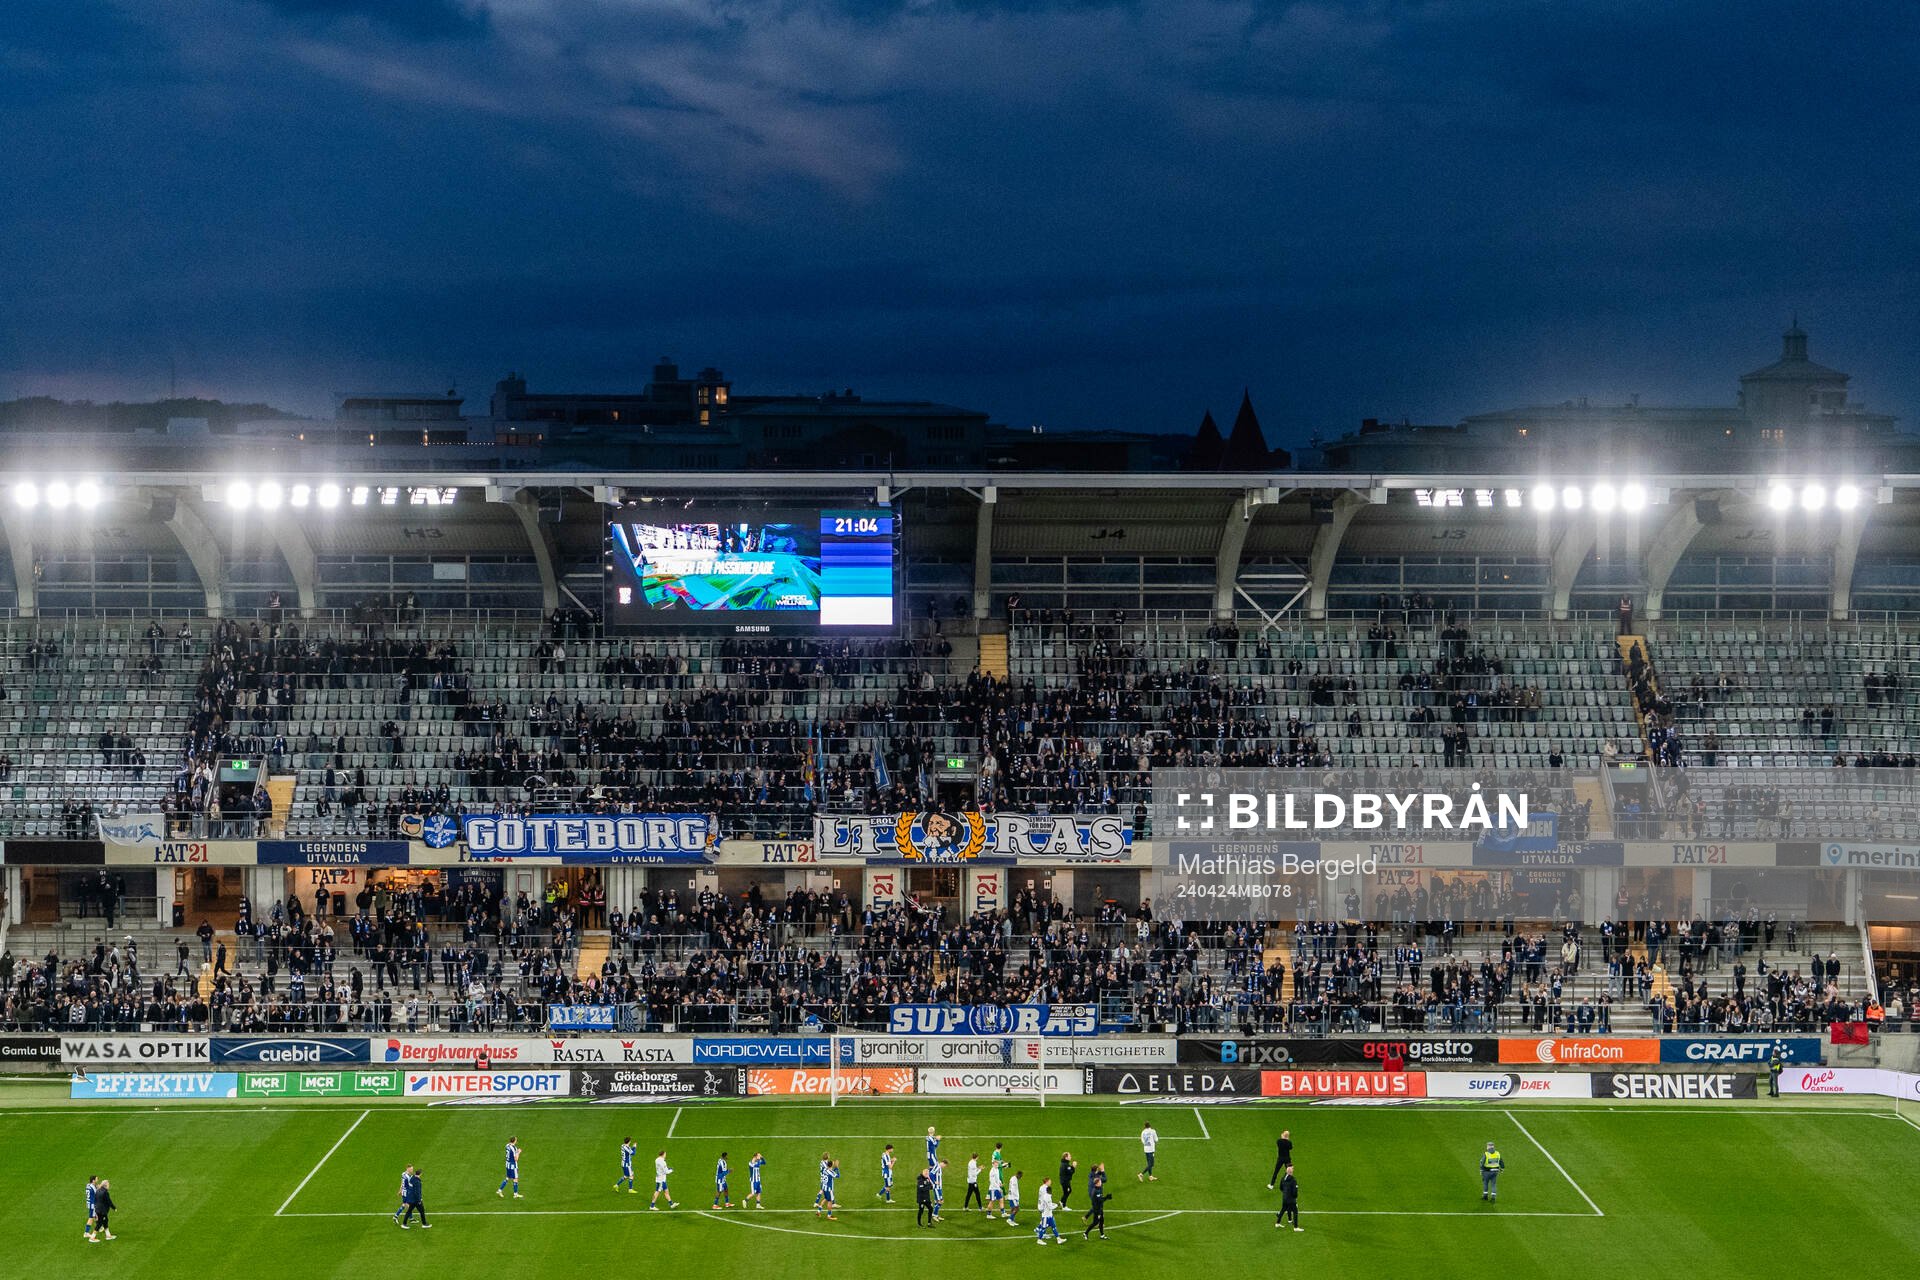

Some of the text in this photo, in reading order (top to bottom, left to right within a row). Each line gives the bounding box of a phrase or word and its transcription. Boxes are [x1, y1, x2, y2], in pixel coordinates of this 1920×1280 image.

[835, 518, 878, 532] 21:04
[403, 528, 444, 539] H3
[1089, 528, 1127, 540] J4
[1431, 528, 1470, 540] J3
[466, 814, 707, 851] GÖTEBORG
[153, 843, 208, 863] FAT21
[300, 844, 367, 852] LEGENDENS
[762, 843, 817, 863] FAT21
[1211, 844, 1278, 853] LEGENDENS
[1369, 845, 1424, 863] FAT21
[1672, 845, 1728, 864] FAT21
[307, 854, 360, 863] UTVALDA
[1522, 856, 1575, 864] UTVALDA
[311, 869, 357, 885] FAT21
[1375, 869, 1423, 886] FAT21
[892, 1007, 966, 1032] SUP
[2, 1045, 38, 1056] Gamla
[65, 1042, 208, 1058] WASA OPTIK
[259, 1045, 320, 1061] cuebid
[402, 1043, 518, 1062] Bergkvarabuss
[553, 1049, 605, 1061] RASTA
[623, 1049, 675, 1061] RASTA
[863, 1040, 924, 1058] granitor
[942, 1040, 1002, 1058] granito
[1046, 1046, 1166, 1057] STENFASTIGHETER
[1220, 1041, 1294, 1063] Brixo.
[1363, 1040, 1473, 1058] ggm gastro
[1560, 1044, 1623, 1058] InfraCom
[1686, 1043, 1770, 1059] CRAFT
[95, 1074, 213, 1092] EFFEKTIV
[251, 1077, 279, 1088] MCR
[305, 1077, 334, 1087] MCR
[360, 1076, 389, 1087] MCR
[431, 1074, 561, 1092] INTERSPORT
[614, 1071, 678, 1083] Göteborgs
[738, 1068, 746, 1094] SELECT
[789, 1071, 872, 1093] Renova
[1149, 1075, 1235, 1090] ELEDA
[1281, 1075, 1406, 1091] BAUHAUS
[1469, 1080, 1507, 1089] SUPER
[1801, 1070, 1836, 1090] Oves
[610, 1082, 695, 1094] Metallpartier
[1613, 1074, 1733, 1098] SERNEKE
